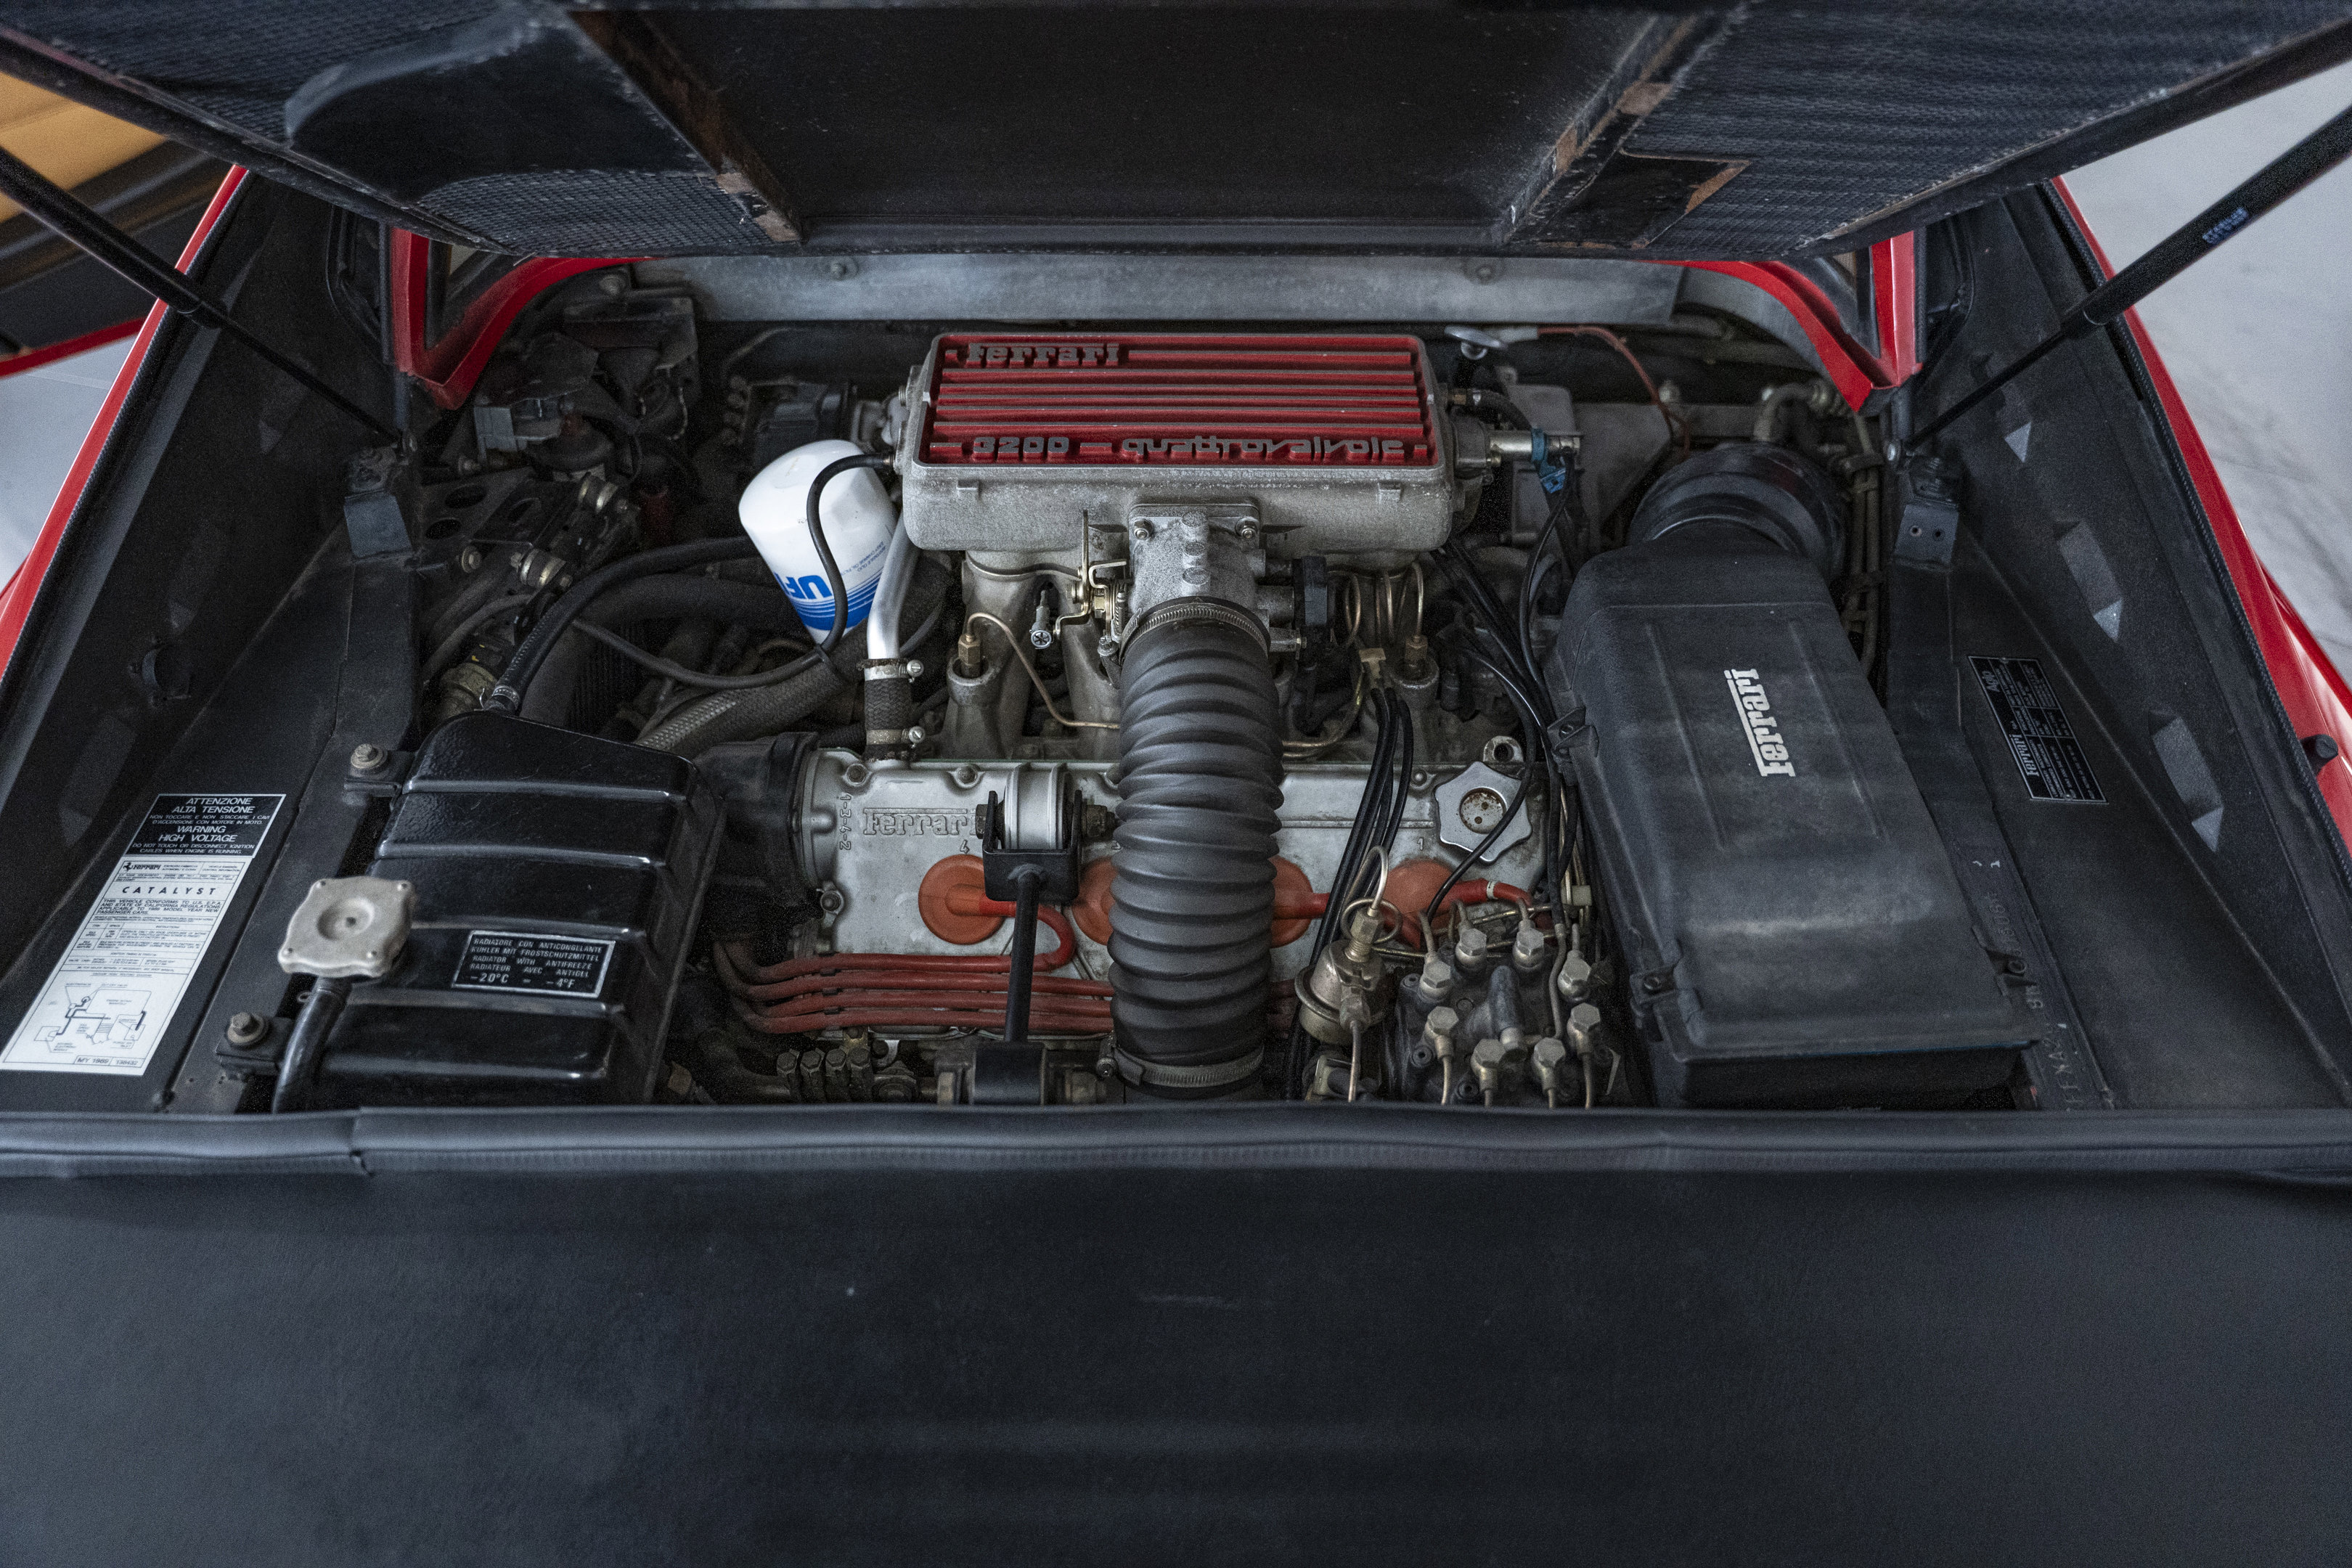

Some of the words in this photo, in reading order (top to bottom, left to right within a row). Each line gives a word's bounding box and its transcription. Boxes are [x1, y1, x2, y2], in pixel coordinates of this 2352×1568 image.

[967, 343, 1119, 363] Ferrari
[973, 436, 1070, 454] 3200
[1122, 436, 1405, 456] quattrovalvole
[1724, 669, 1796, 777] Ferrari
[2009, 734, 2040, 777] Ferrari
[122, 886, 216, 895] CATALYST
[539, 942, 603, 953] ANTICONGELANTE
[520, 950, 599, 961] FROSTSCHUTZMITTEL
[545, 960, 592, 970] ANTIFREEZE
[556, 969, 589, 978] ANTIGEL
